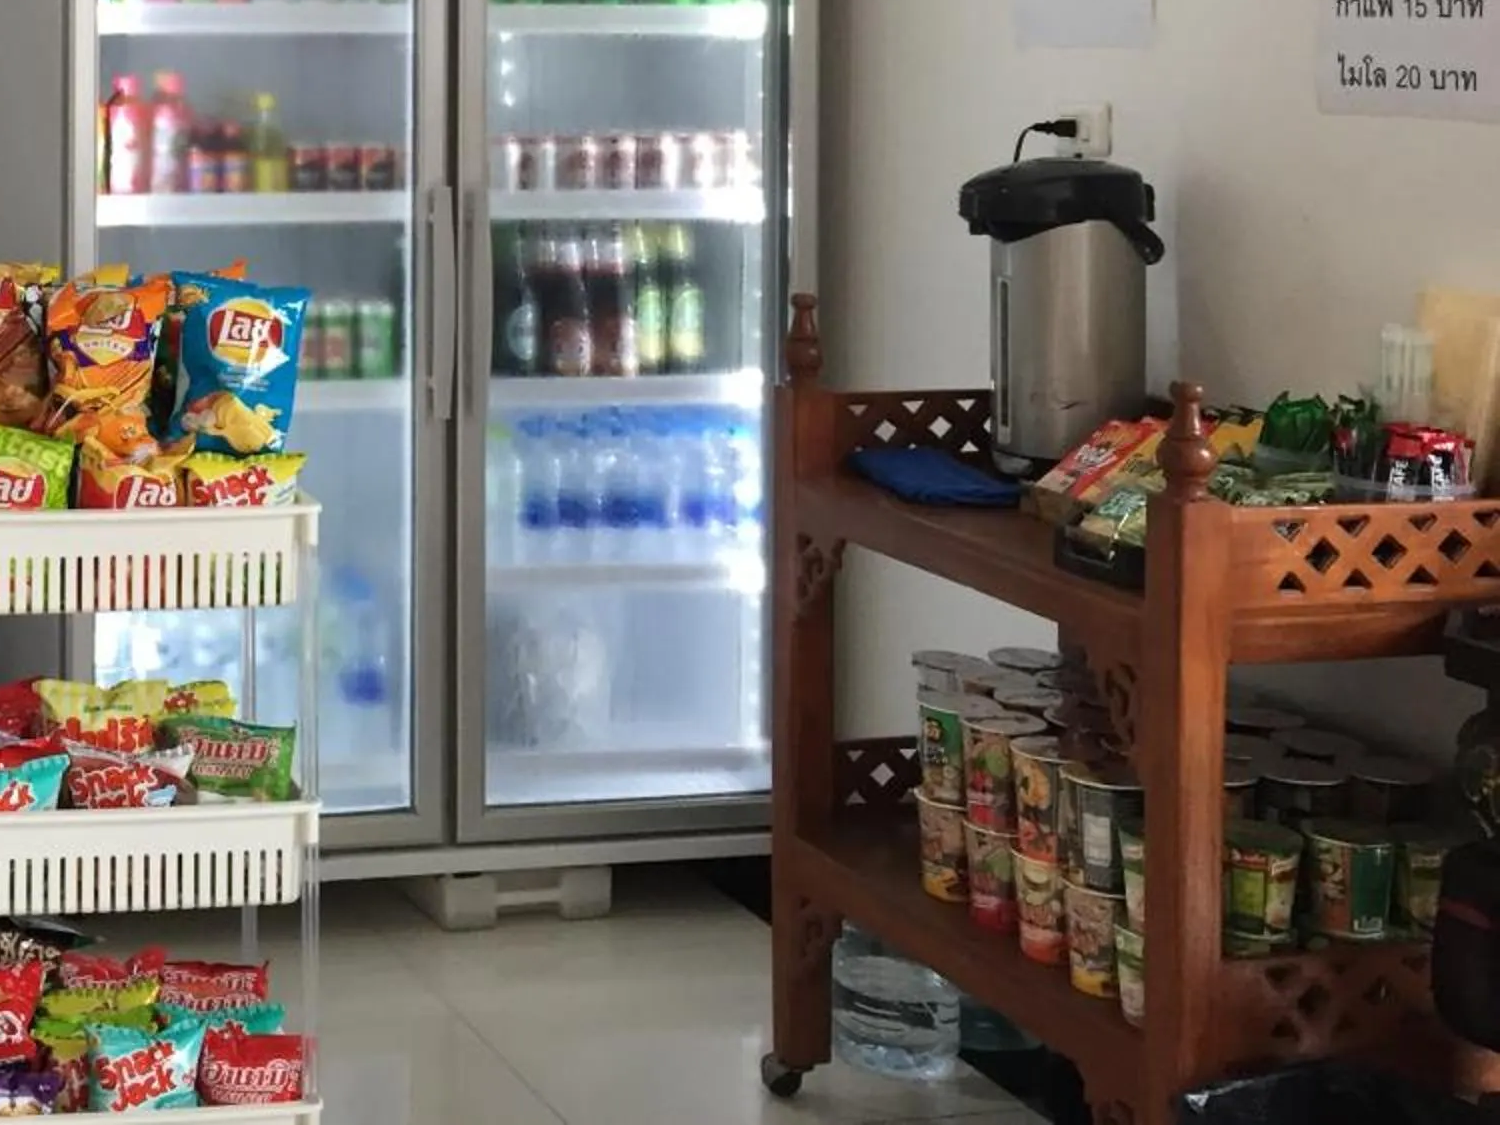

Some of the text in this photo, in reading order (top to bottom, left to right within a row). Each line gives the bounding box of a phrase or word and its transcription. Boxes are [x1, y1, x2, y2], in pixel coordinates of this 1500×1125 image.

[1337, 51, 1478, 92] ไมโล 20 บาท
[93, 1037, 177, 1091] Snack
[110, 1063, 177, 1113] Jack
